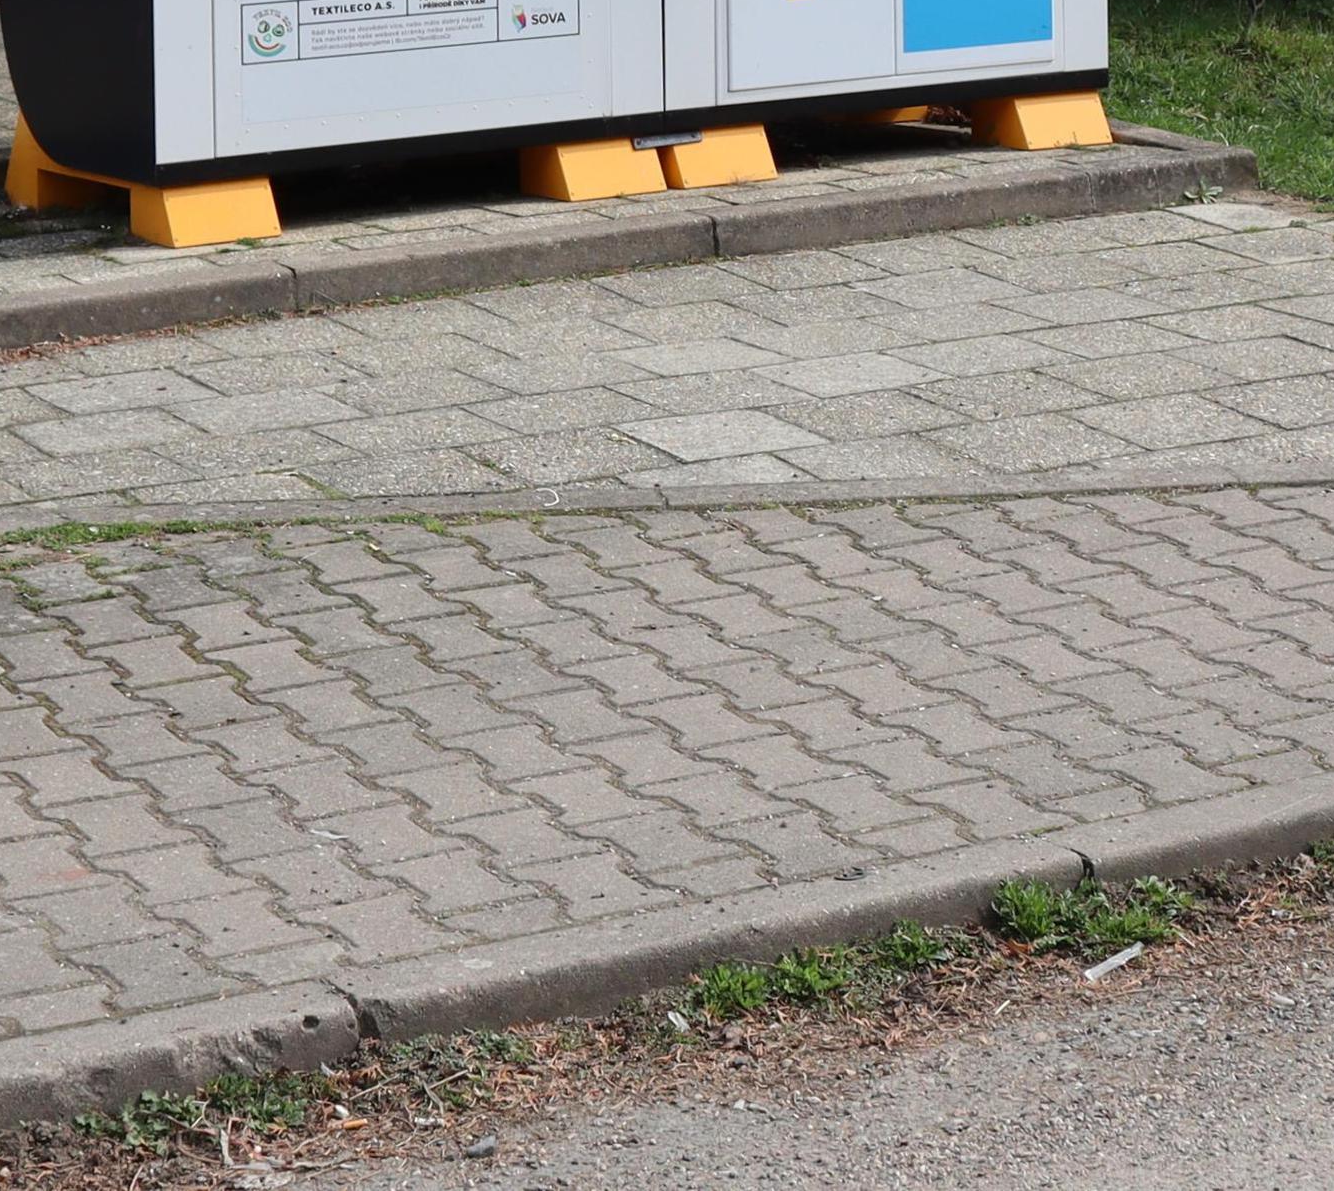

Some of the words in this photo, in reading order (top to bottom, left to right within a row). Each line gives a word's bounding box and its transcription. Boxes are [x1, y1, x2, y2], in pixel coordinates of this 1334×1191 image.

[311, 3, 373, 16] TEXTILECO
[375, 1, 396, 11] A.S.
[530, 12, 566, 26] SOVA
